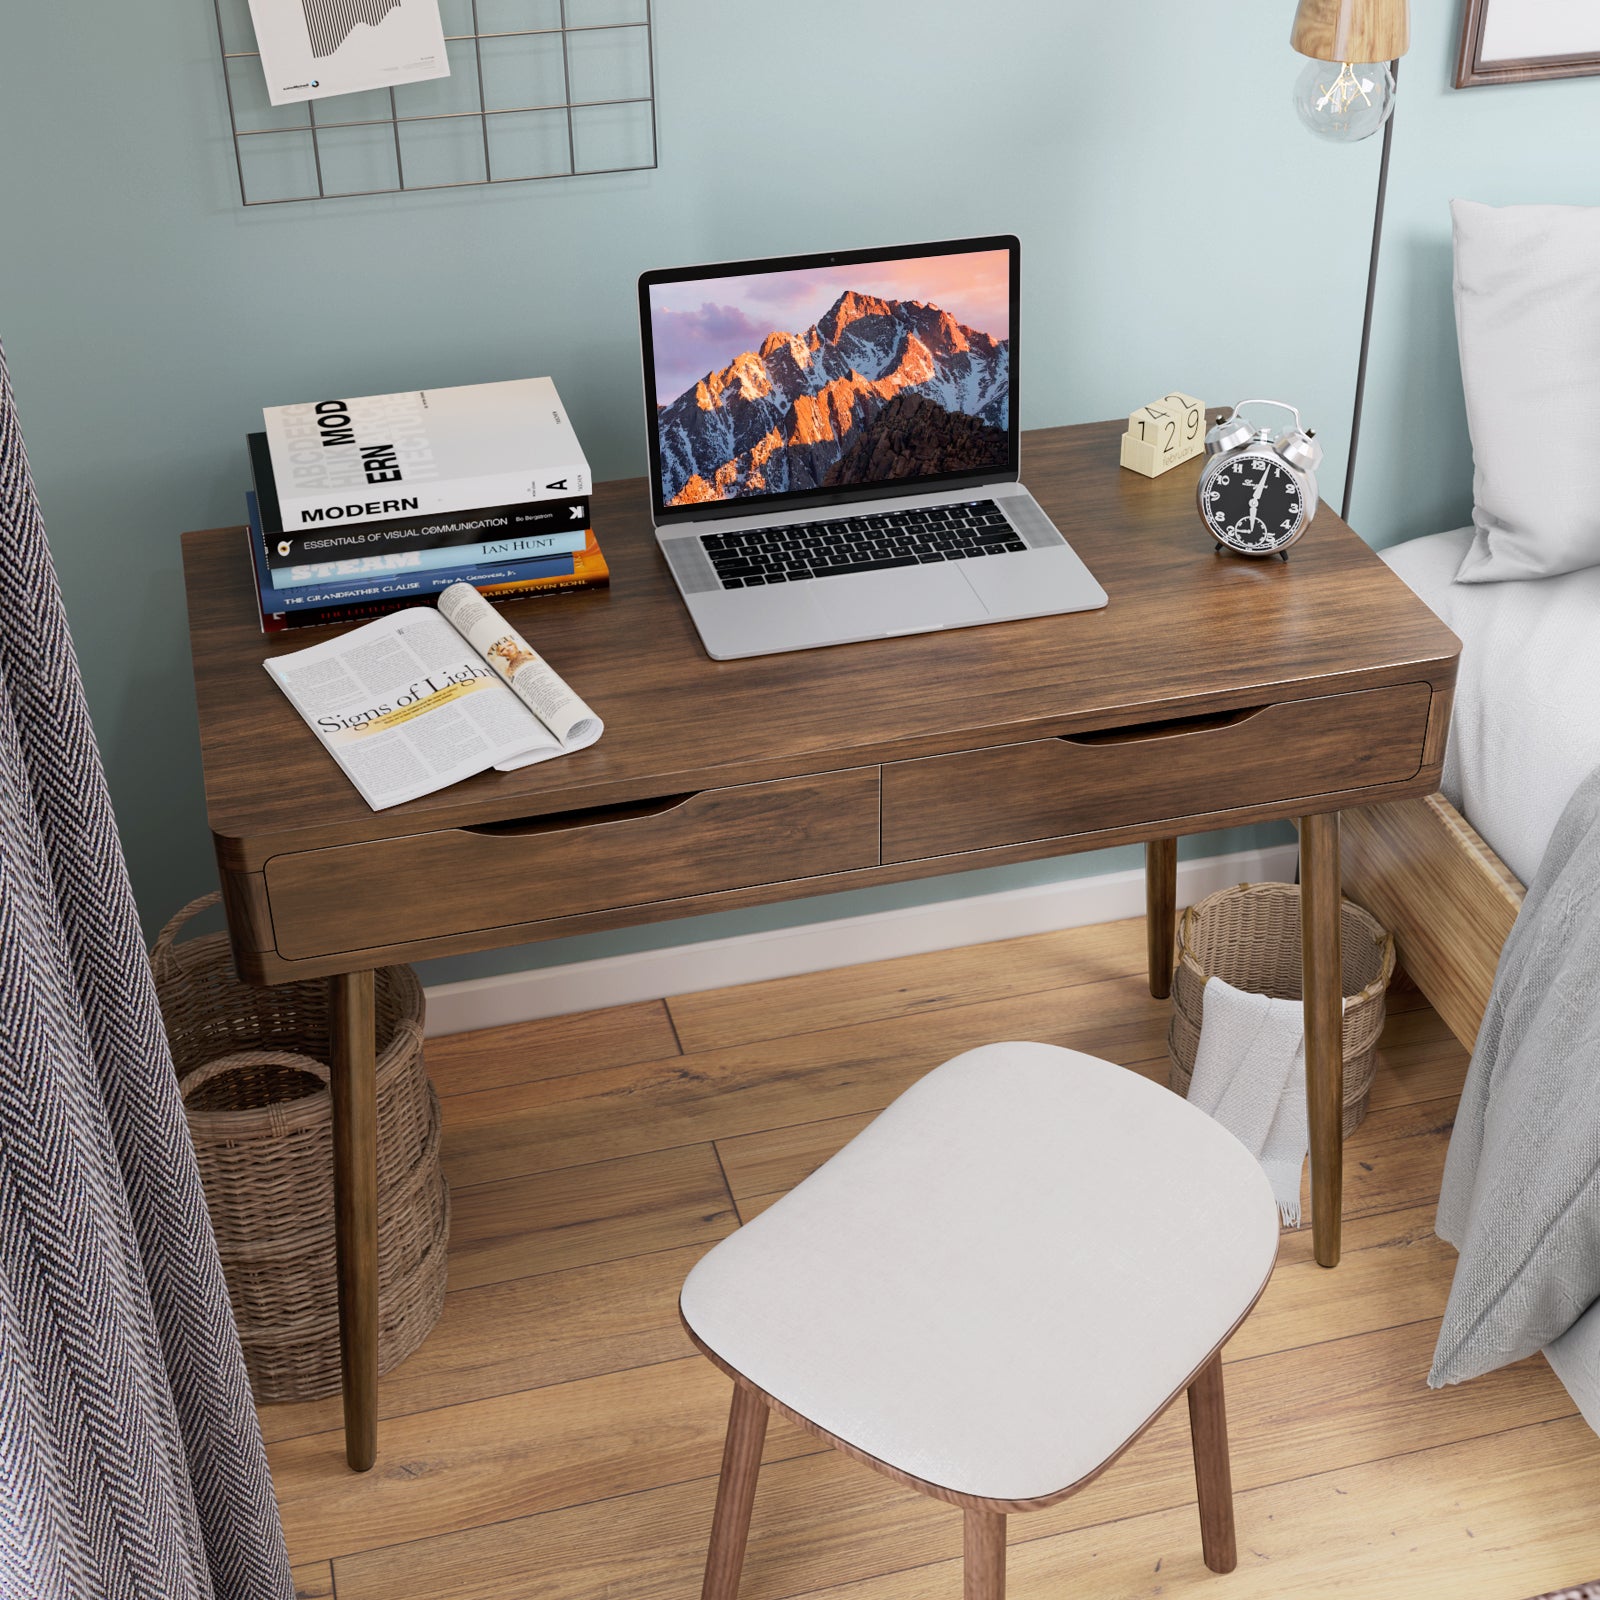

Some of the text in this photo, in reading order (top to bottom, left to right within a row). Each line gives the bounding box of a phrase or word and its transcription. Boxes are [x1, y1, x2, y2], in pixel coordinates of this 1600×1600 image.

[315, 400, 356, 447] MOD
[1138, 420, 1146, 441] 1
[359, 444, 402, 484] ERN
[1231, 463, 1243, 474] 11
[1251, 459, 1266, 471] 12
[1273, 468, 1281, 478] 1
[545, 478, 568, 490] A
[1216, 475, 1230, 486] 10
[1285, 484, 1296, 494] 2
[1210, 491, 1220, 501] 9
[301, 496, 419, 523] MODERN
[1288, 503, 1299, 514] 3
[1215, 511, 1226, 522] 8
[1280, 519, 1291, 530] 4
[303, 517, 509, 551] ESSENTIALS OF VISUAL COMMUNICATION
[283, 582, 420, 606] THE GRANDFATHER CLAUSE
[481, 579, 588, 597] BARRY STEVEN KOHL
[316, 703, 393, 734] Signs
[396, 683, 421, 708] of
